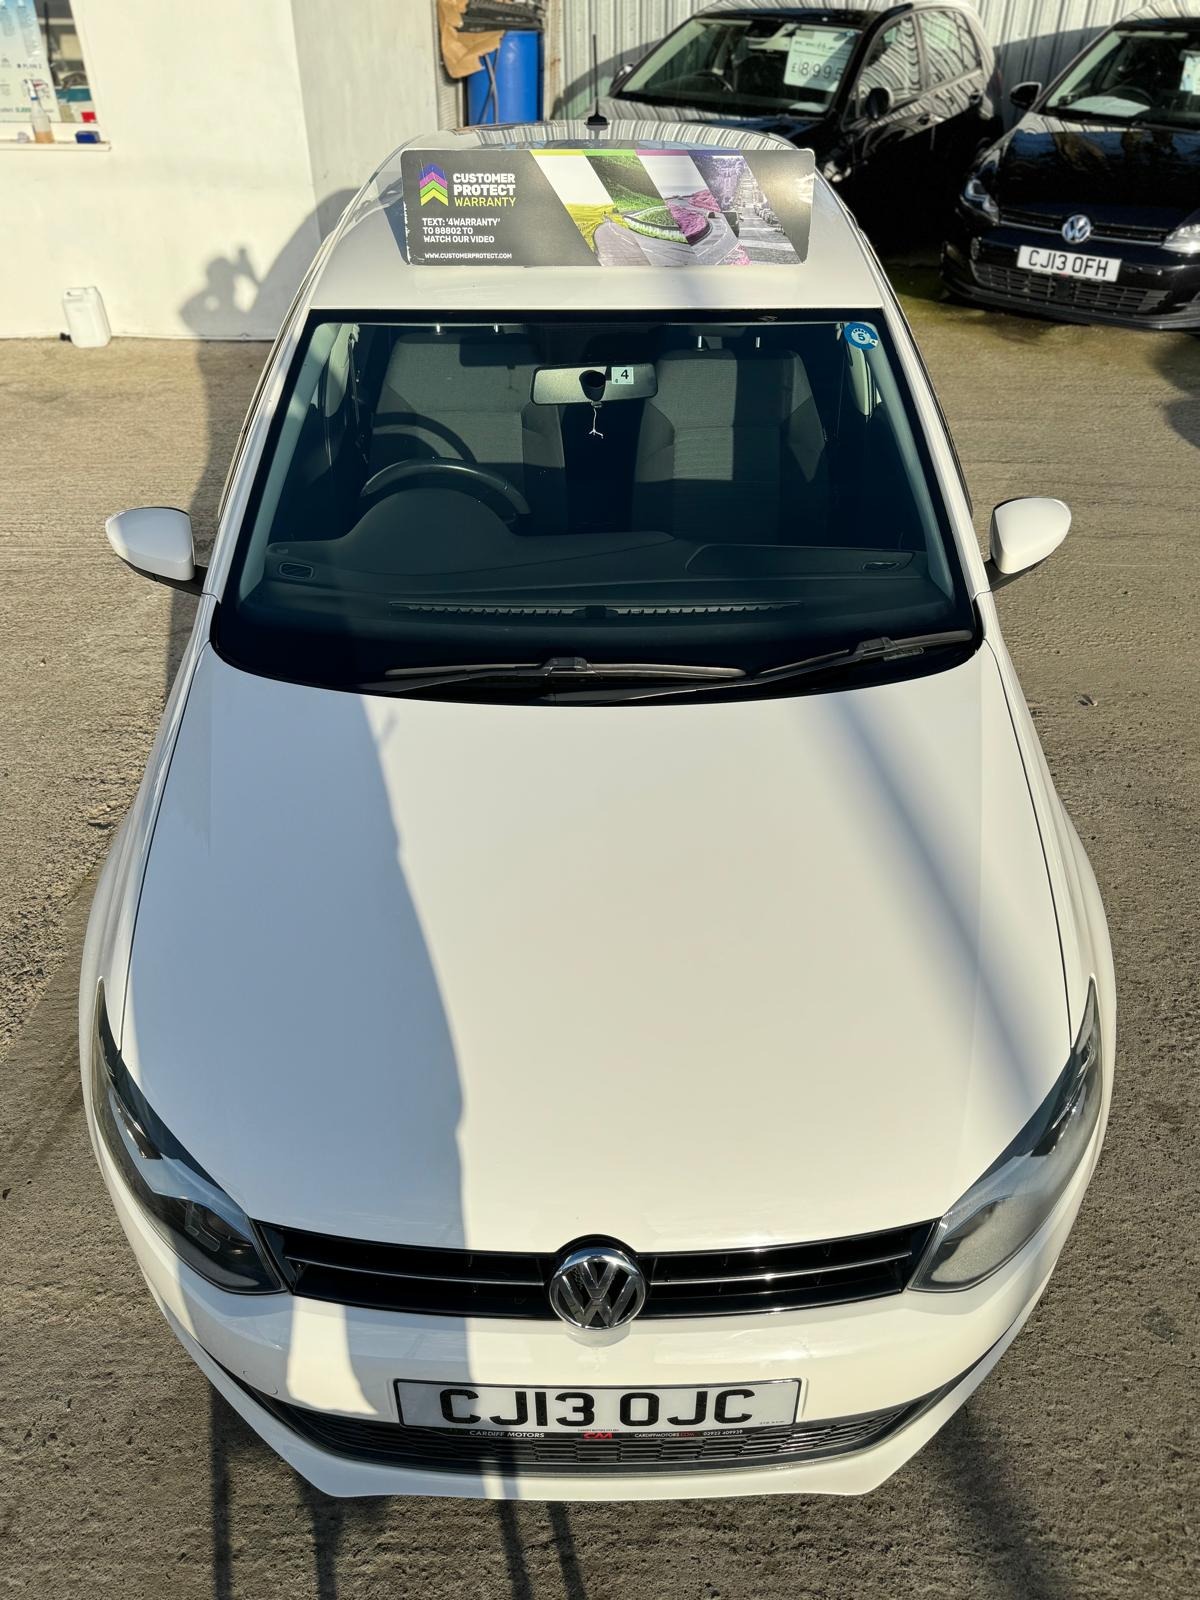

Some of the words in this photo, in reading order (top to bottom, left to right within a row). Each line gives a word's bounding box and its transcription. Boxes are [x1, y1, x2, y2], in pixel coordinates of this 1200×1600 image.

[453, 173, 516, 183] CUSTOMER
[453, 184, 516, 195] PROTECT
[454, 197, 516, 207] WARRANTY
[422, 218, 445, 226] TEXT:
[423, 227, 434, 235] TO
[435, 227, 461, 235] 88802
[463, 227, 473, 235] TO
[1028, 249, 1068, 271] CJ13
[1072, 256, 1109, 277] OFH
[857, 333, 866, 341] 5
[620, 369, 630, 380] 4
[440, 1388, 595, 1427] CJ13
[619, 1389, 756, 1426] OJC
